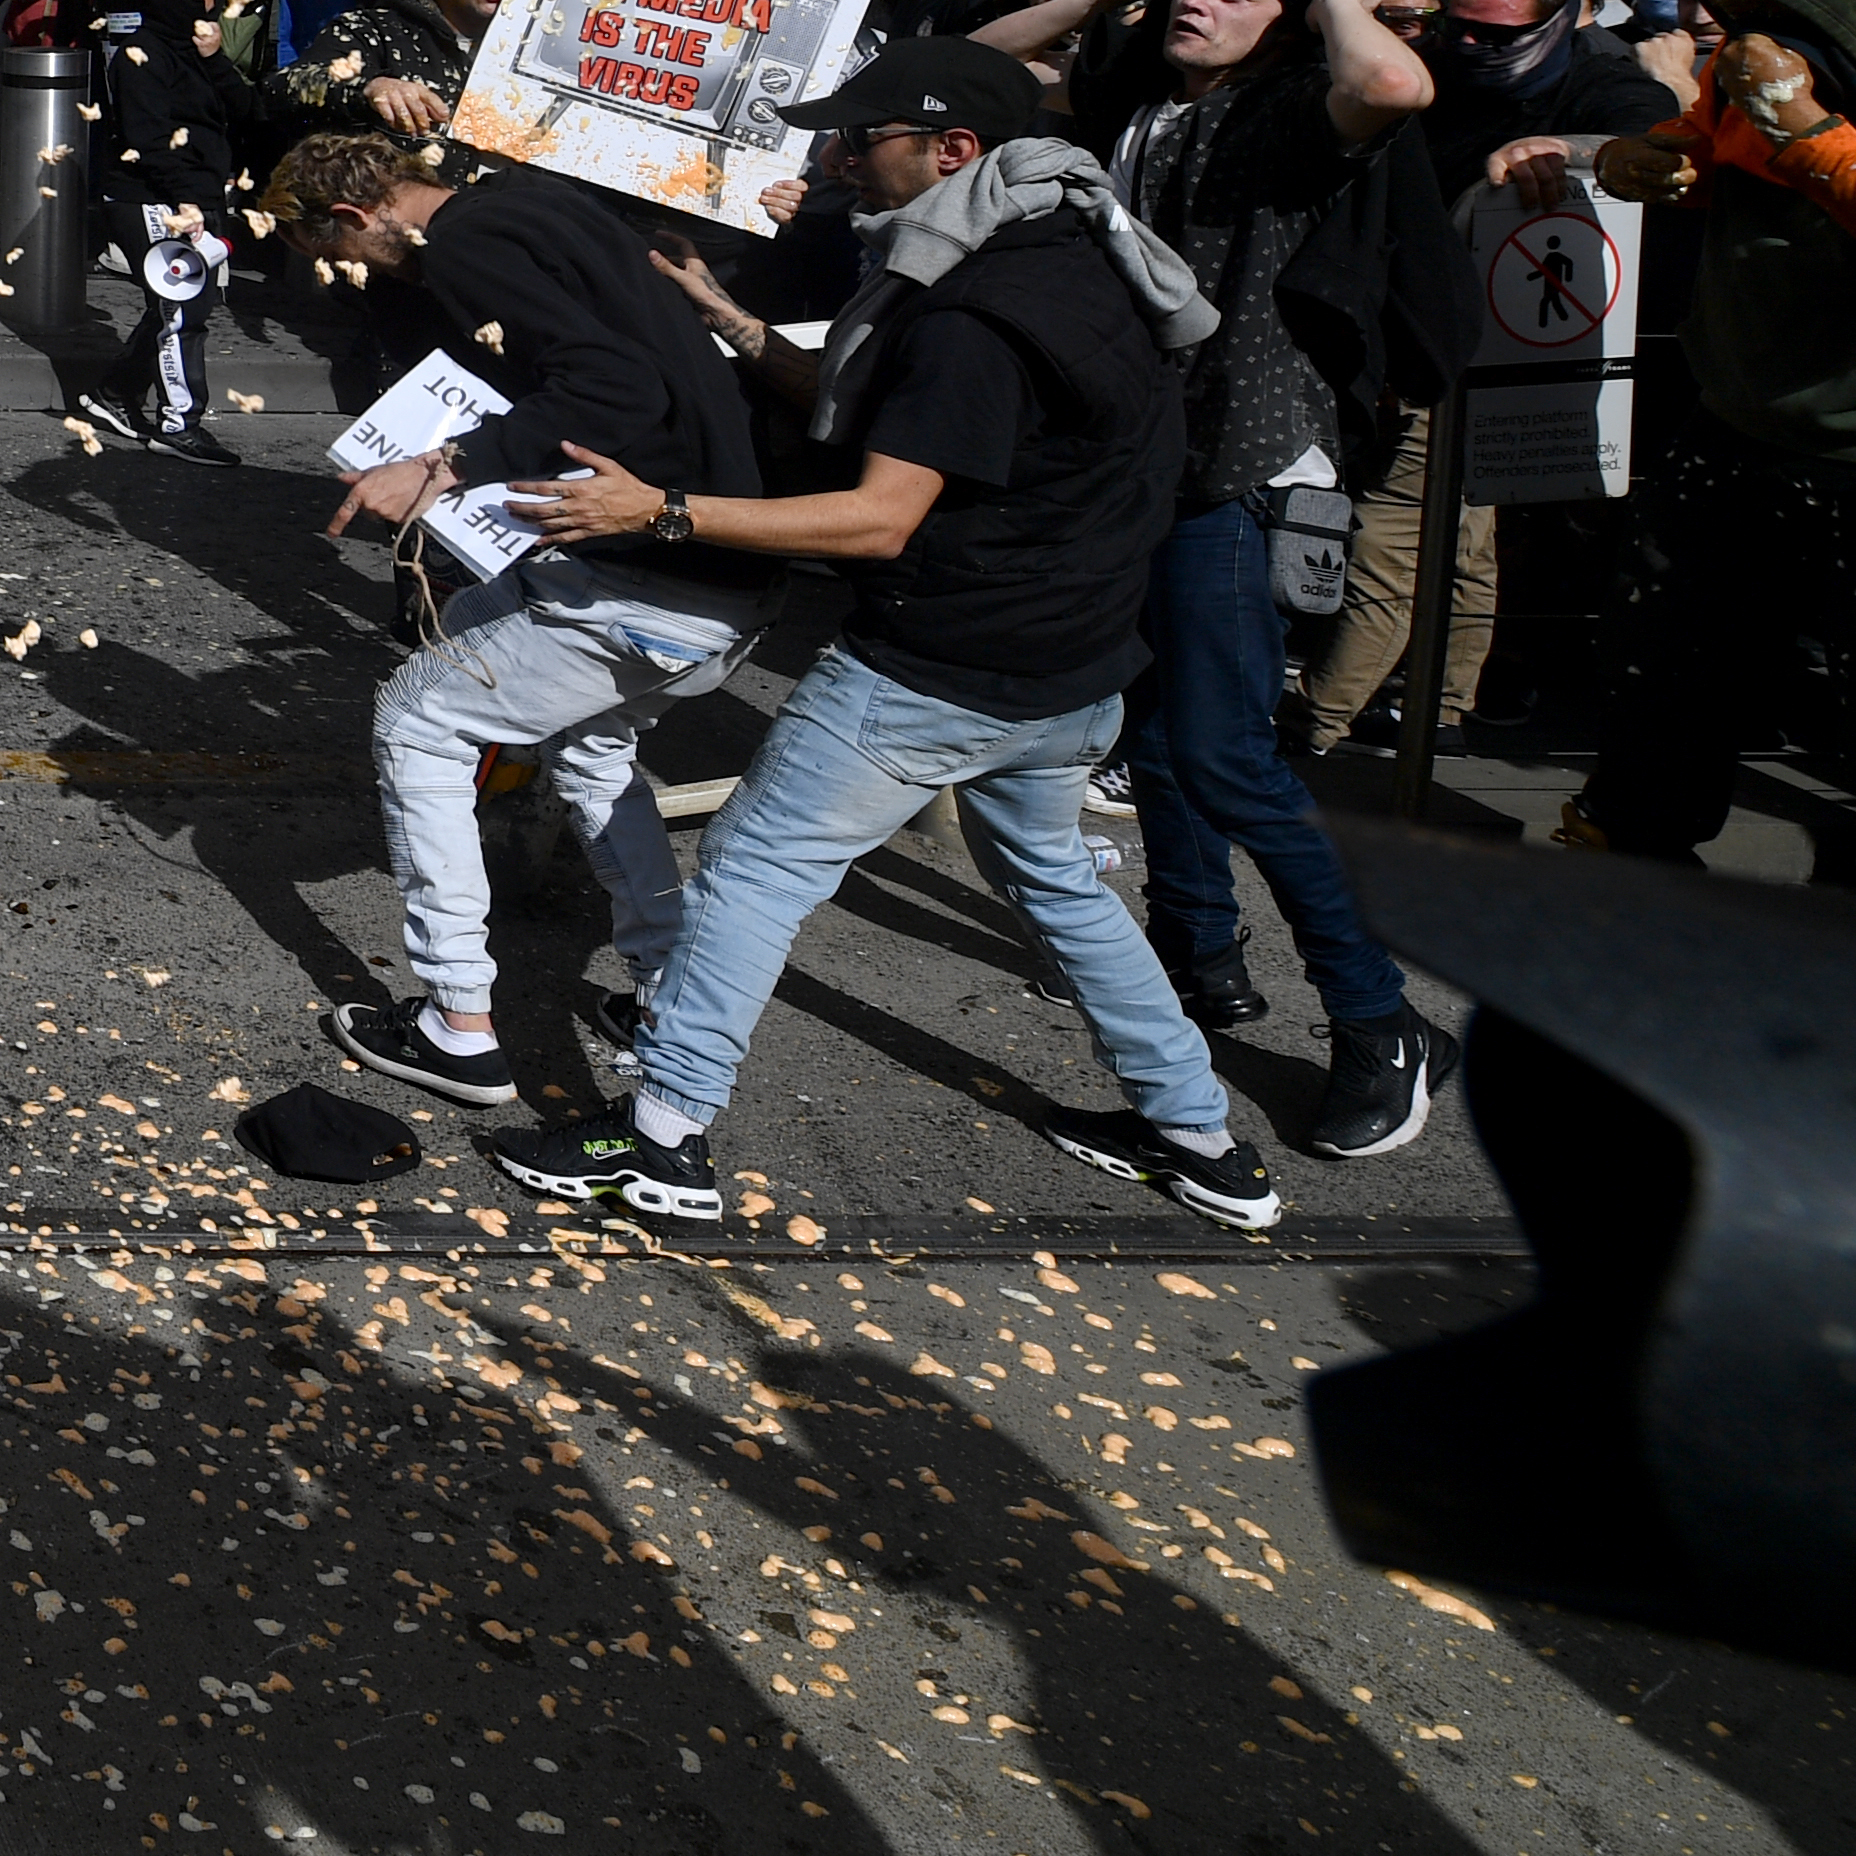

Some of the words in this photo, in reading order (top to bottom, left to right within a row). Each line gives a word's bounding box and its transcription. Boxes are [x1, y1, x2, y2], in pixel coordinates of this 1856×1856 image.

[581, 9, 622, 48] IS
[633, 22, 709, 69] THE
[578, 55, 700, 112] VIRUS
[1473, 414, 1528, 429] Entering
[1531, 410, 1588, 426] platform
[1474, 431, 1517, 446] strictly
[1519, 425, 1590, 443] prohibited.
[1473, 450, 1517, 465] Heavy
[1519, 444, 1579, 461] penalties
[1581, 443, 1621, 458] apply.
[1473, 463, 1539, 479] Offenders
[1542, 458, 1622, 475] prosecuted.
[462, 506, 523, 556] THE
